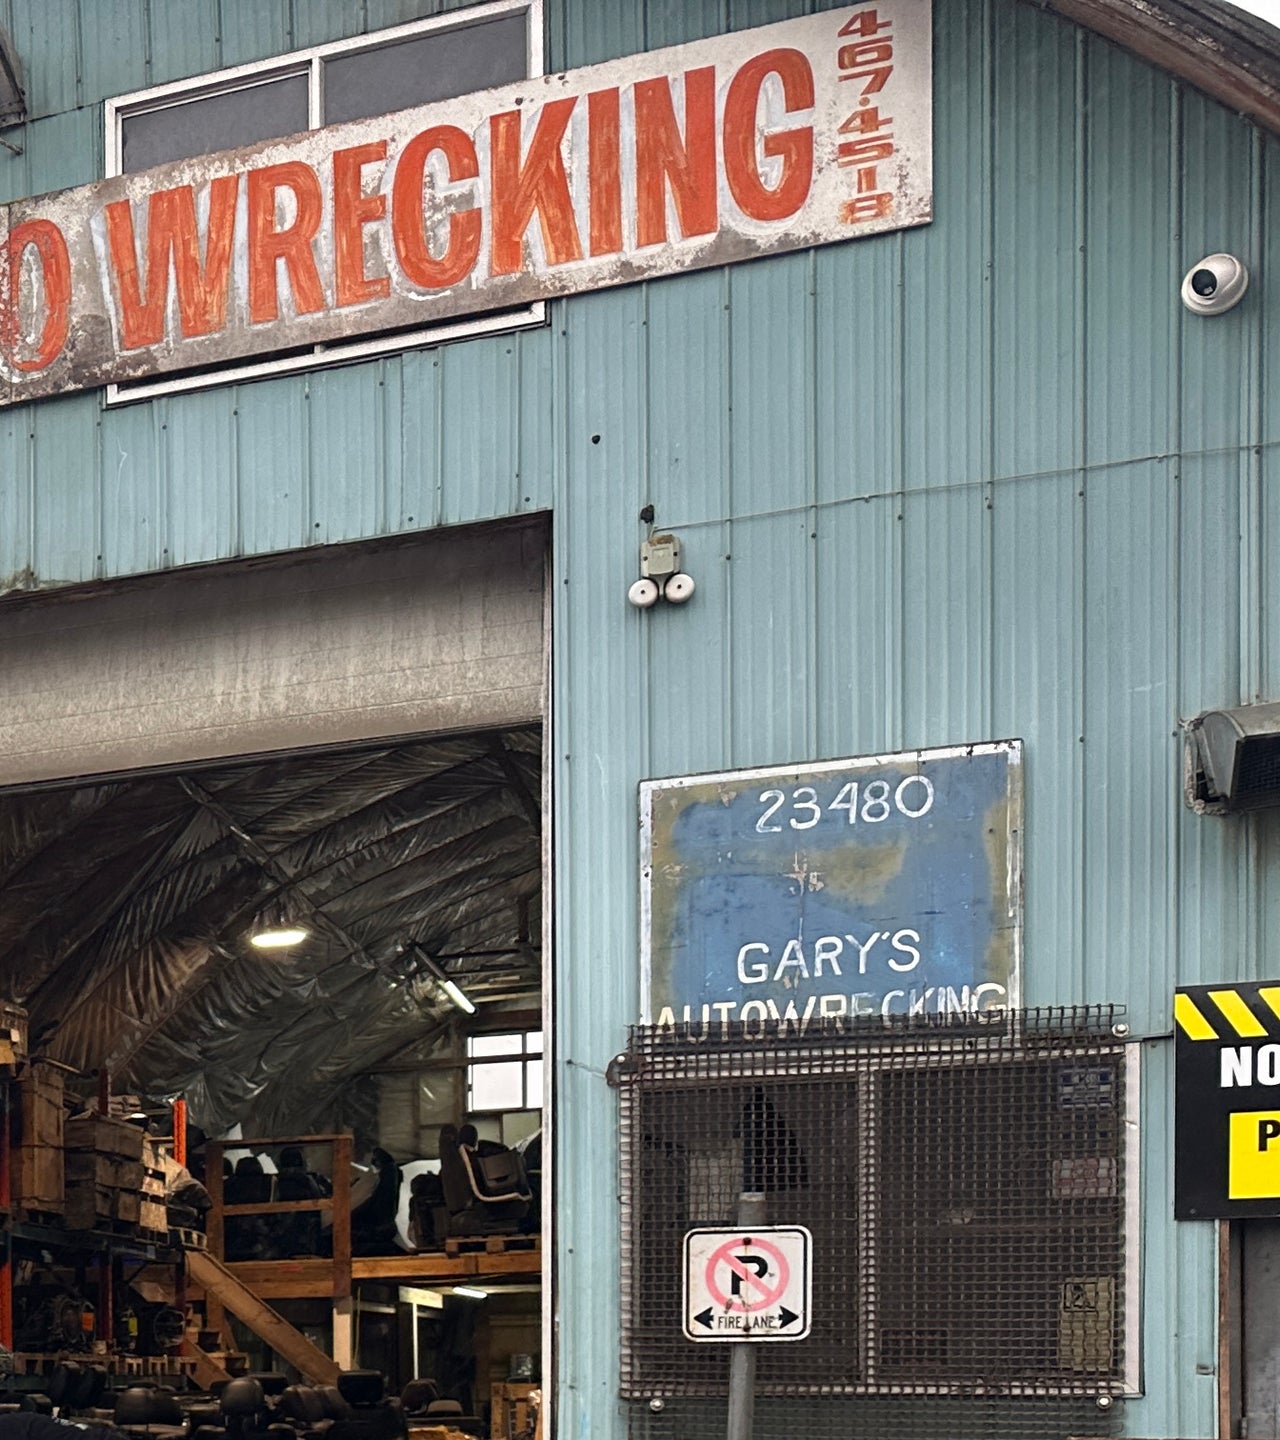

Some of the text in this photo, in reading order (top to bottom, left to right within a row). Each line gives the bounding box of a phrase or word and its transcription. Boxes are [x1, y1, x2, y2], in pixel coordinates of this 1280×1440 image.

[103, 46, 816, 352] WRECKING
[755, 774, 935, 834] 23480
[736, 928, 921, 985] GARY'S
[717, 1315, 742, 1330] FIRE
